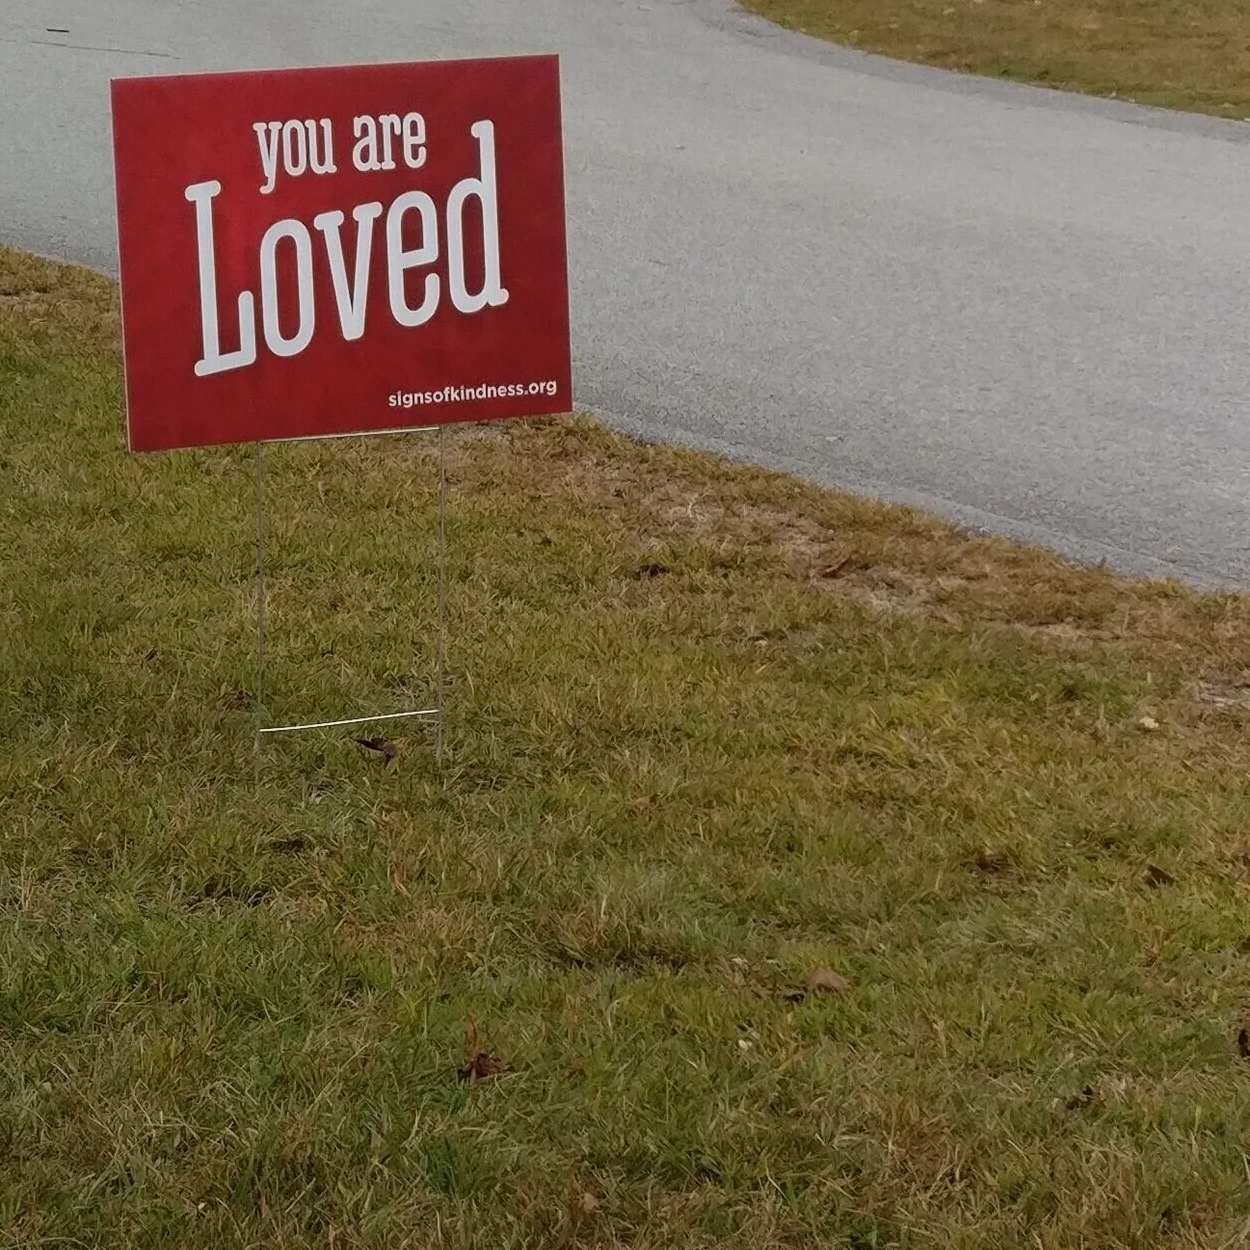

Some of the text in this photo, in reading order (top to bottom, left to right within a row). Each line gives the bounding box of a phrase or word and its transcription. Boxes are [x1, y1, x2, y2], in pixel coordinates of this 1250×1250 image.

[253, 111, 426, 194] you are
[184, 119, 509, 377] Loved
[388, 379, 558, 409] signsofkindness.org
